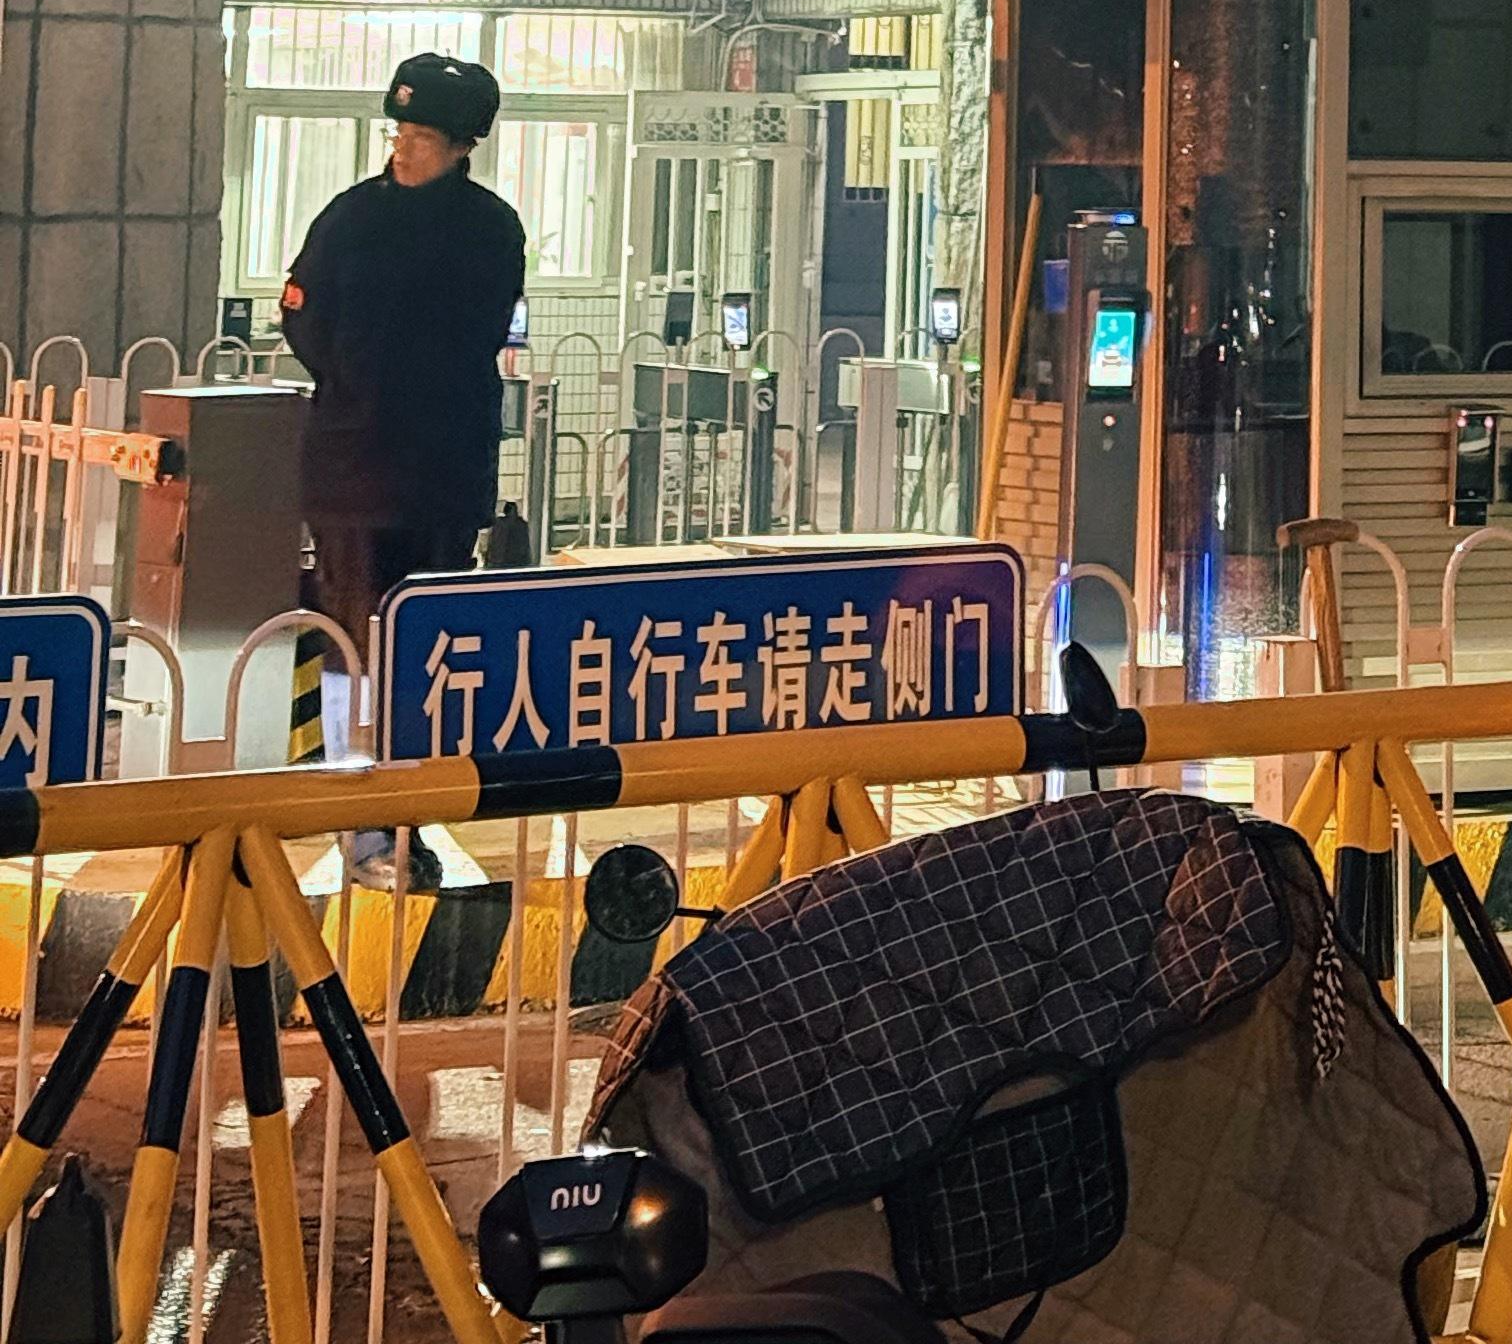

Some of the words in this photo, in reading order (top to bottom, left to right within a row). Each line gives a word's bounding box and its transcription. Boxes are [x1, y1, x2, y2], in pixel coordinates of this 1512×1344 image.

[0, 654, 54, 789] 内
[422, 596, 991, 758] 行人自行车请走侧门
